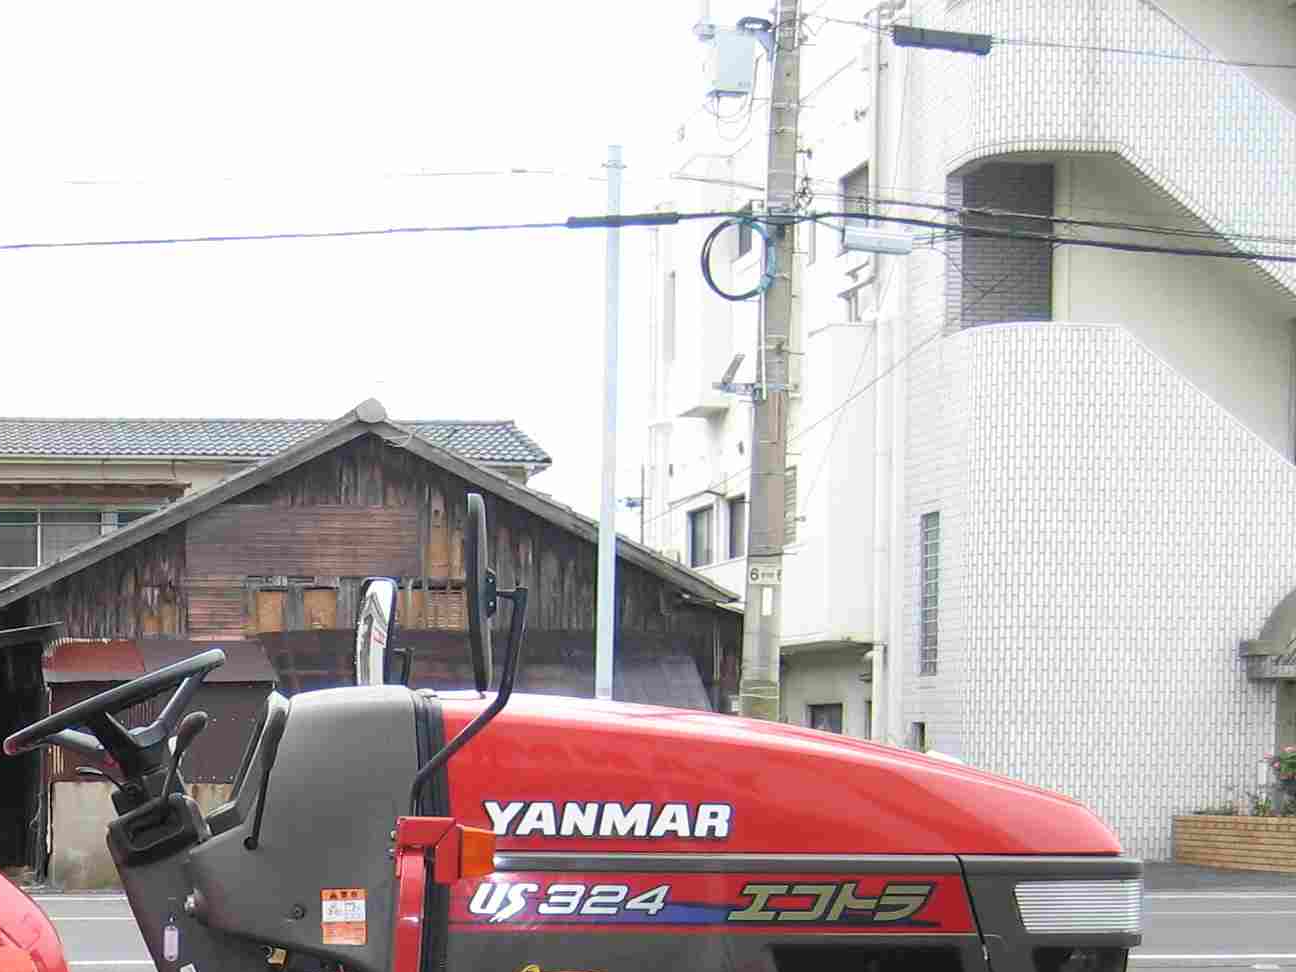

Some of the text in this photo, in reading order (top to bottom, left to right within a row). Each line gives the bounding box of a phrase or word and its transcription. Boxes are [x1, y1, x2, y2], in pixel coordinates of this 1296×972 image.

[483, 801, 731, 838] YANMAR
[727, 883, 932, 922] エコトラ
